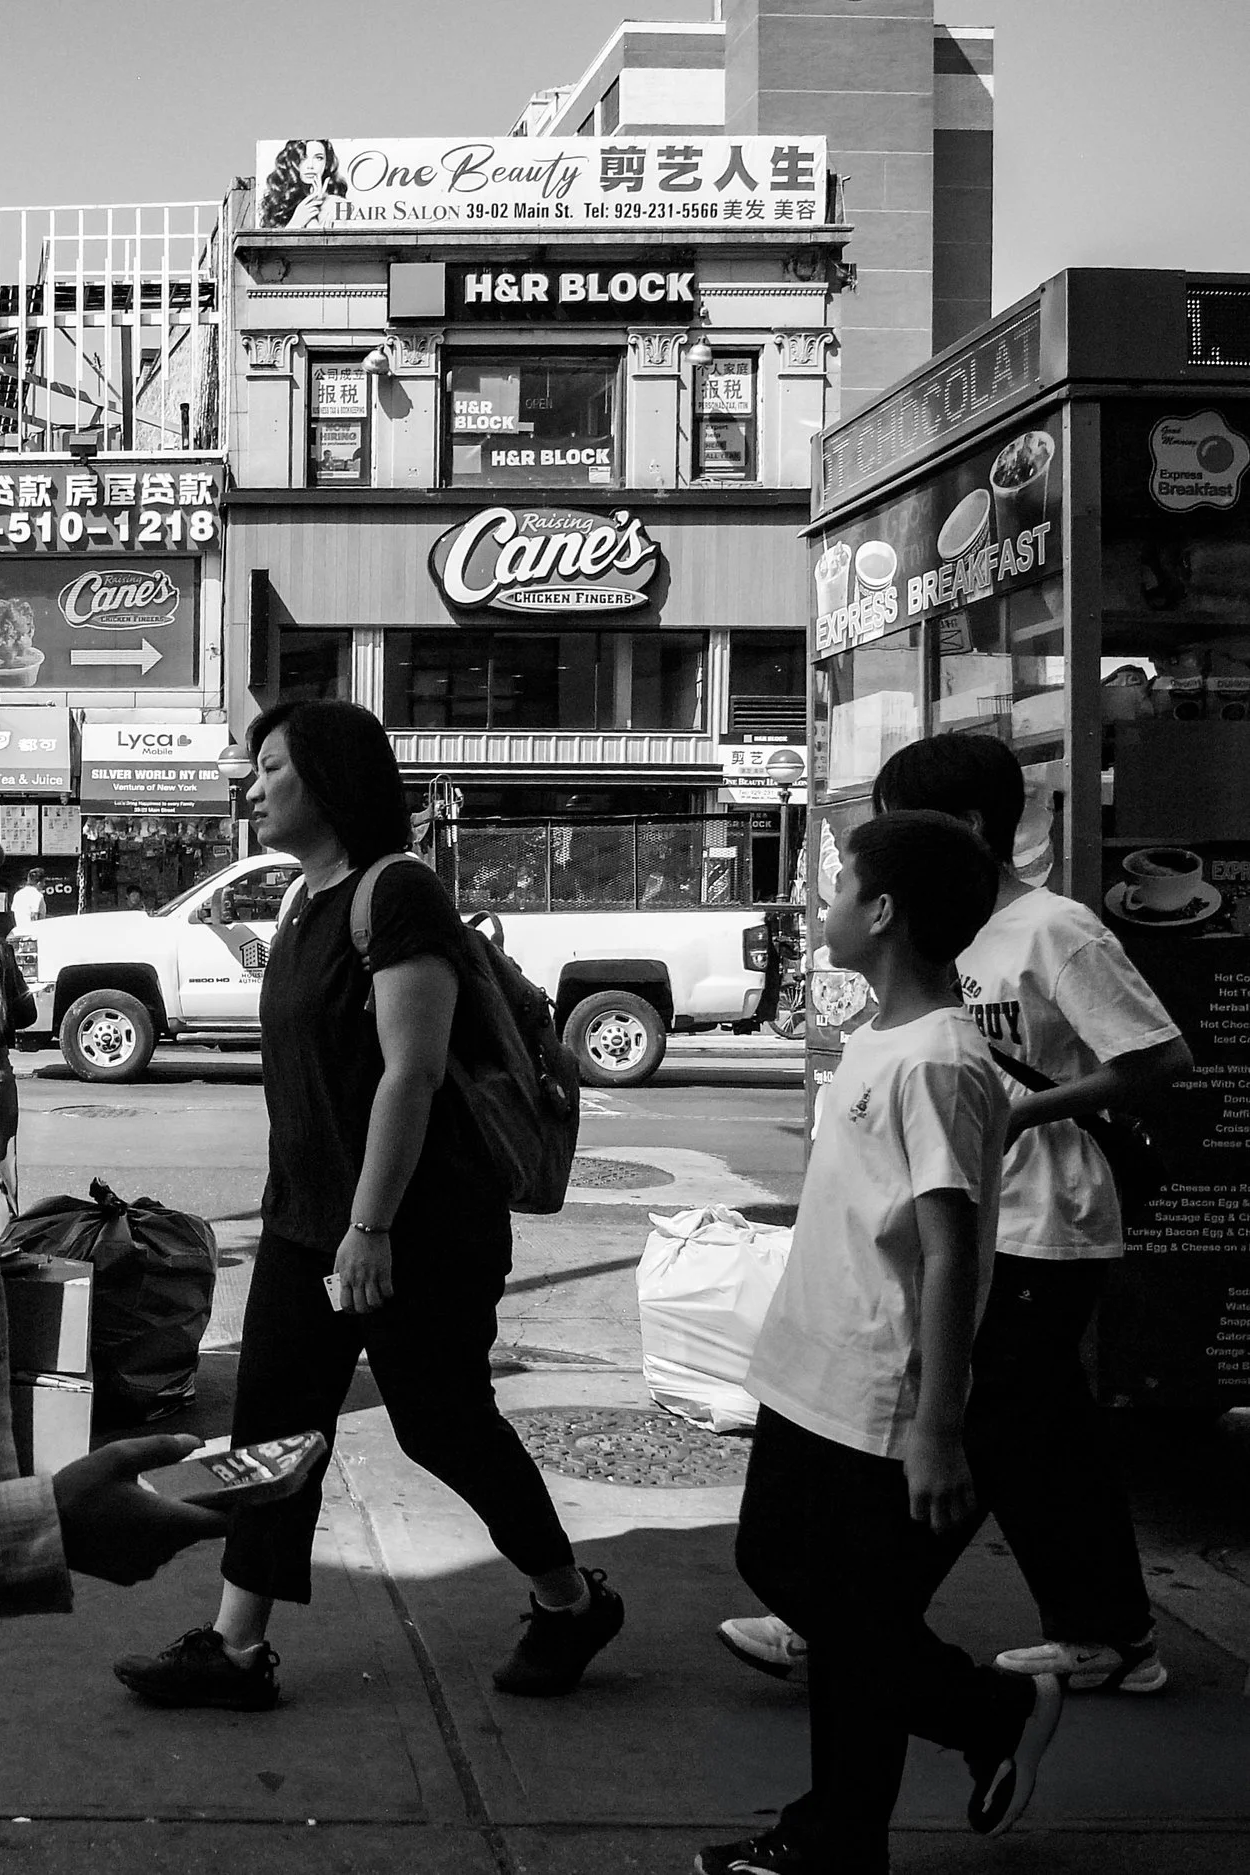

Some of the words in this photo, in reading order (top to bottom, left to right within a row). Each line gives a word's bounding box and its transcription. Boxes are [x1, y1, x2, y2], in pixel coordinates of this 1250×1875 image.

[348, 150, 438, 192] One
[441, 143, 590, 199] Beauty
[600, 145, 815, 193] 剪艺人生
[335, 200, 387, 221] HAIR
[392, 200, 461, 221] SALON
[466, 202, 509, 219] 39-02
[513, 202, 549, 219] Main
[554, 202, 574, 219] St.
[584, 202, 609, 219] Tel:
[614, 202, 719, 219] 929-231-5566
[723, 199, 766, 220] 美发
[774, 199, 817, 220] 美容
[464, 272, 549, 303] H&R
[558, 271, 696, 303] BLOCK
[314, 368, 364, 381] 公司成立
[697, 363, 749, 376] 个人家庭
[318, 384, 358, 404] 报税
[702, 380, 743, 400] 报税
[454, 401, 493, 415] H&R
[525, 398, 553, 409] OPEN
[454, 415, 515, 430] BLOCK
[491, 450, 536, 467] H&R
[540, 448, 610, 466] BLOCK
[1159, 469, 1203, 481] Express
[65, 473, 213, 508] 房屋贷款
[1158, 481, 1233, 497] Breakfast
[521, 513, 594, 534] Raising
[443, 507, 656, 604] Cane's
[104, 575, 142, 585] Raising
[815, 586, 898, 651] EXPRESS
[907, 521, 1051, 616] BREAKFAST
[65, 572, 175, 623] Cane's
[514, 591, 570, 604] CHICKEN
[575, 592, 632, 604] FINGERS
[117, 731, 174, 750] Lyca
[142, 748, 174, 756] Mobile
[18, 774, 29, 785] &
[31, 773, 63, 785] Juice
[91, 769, 133, 780] SILVER
[134, 769, 177, 780] WORLD
[179, 769, 197, 780] NY
[198, 769, 220, 780] INC
[113, 783, 144, 792] Venture
[146, 783, 156, 792] of
[157, 783, 177, 792] New
[178, 783, 198, 792] York
[1214, 973, 1232, 983] Hot
[1219, 988, 1237, 998] Hot
[1210, 1002, 1250, 1013] Herbal
[1200, 1019, 1220, 1029] Hot
[1214, 1035, 1236, 1044] Iced
[1210, 1079, 1235, 1089] With
[1202, 1139, 1242, 1148] Cheese
[1170, 1183, 1211, 1192] Cheese
[1143, 1199, 1178, 1208] urkey
[1181, 1198, 1215, 1207] Bacon
[1217, 1198, 1239, 1209] Egg
[1154, 1213, 1200, 1223] Sausage
[1203, 1213, 1225, 1224] Egg
[1228, 1213, 1236, 1221] &
[1126, 1228, 1162, 1238] Turkey
[1165, 1227, 1199, 1236] Bacon
[1201, 1227, 1223, 1238] Egg
[1226, 1227, 1235, 1236] &
[1146, 1243, 1167, 1254] Egg
[1170, 1243, 1178, 1251] &
[1181, 1243, 1221, 1251] Cheese
[1206, 1346, 1245, 1358] Orange
[1218, 1362, 1239, 1371] Red
